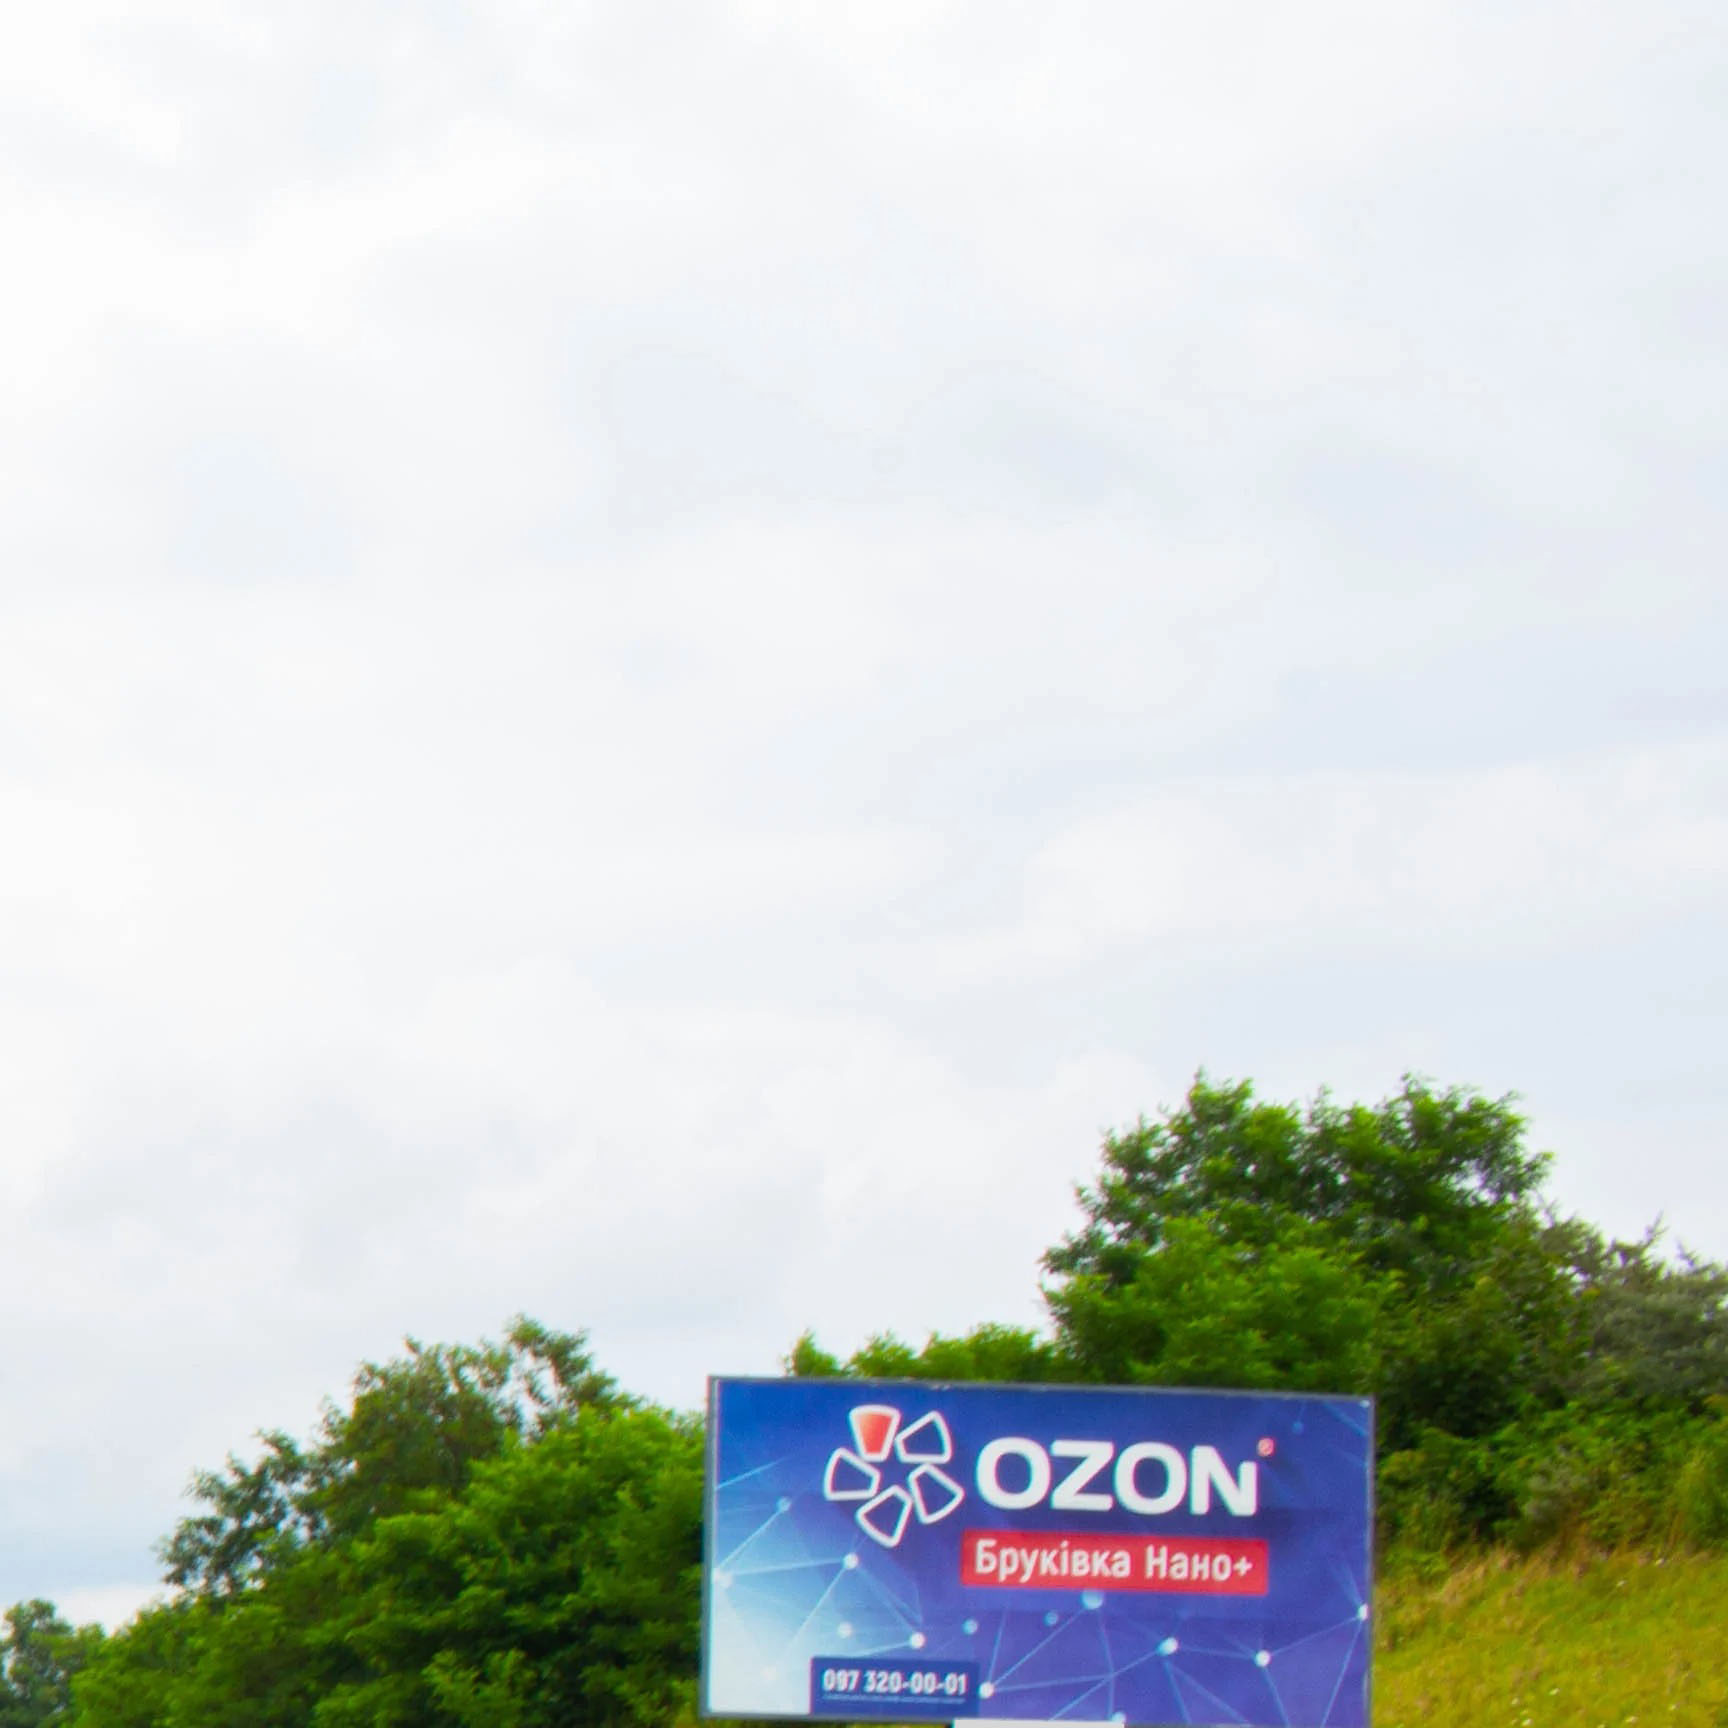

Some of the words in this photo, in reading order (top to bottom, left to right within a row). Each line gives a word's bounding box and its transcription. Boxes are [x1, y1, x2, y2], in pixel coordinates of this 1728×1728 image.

[975, 1436, 1257, 1517] OZON
[974, 1538, 1132, 1583] Бруківка
[1145, 1545, 1254, 1582] Нано+
[863, 1670, 968, 1696] 320-00-01
